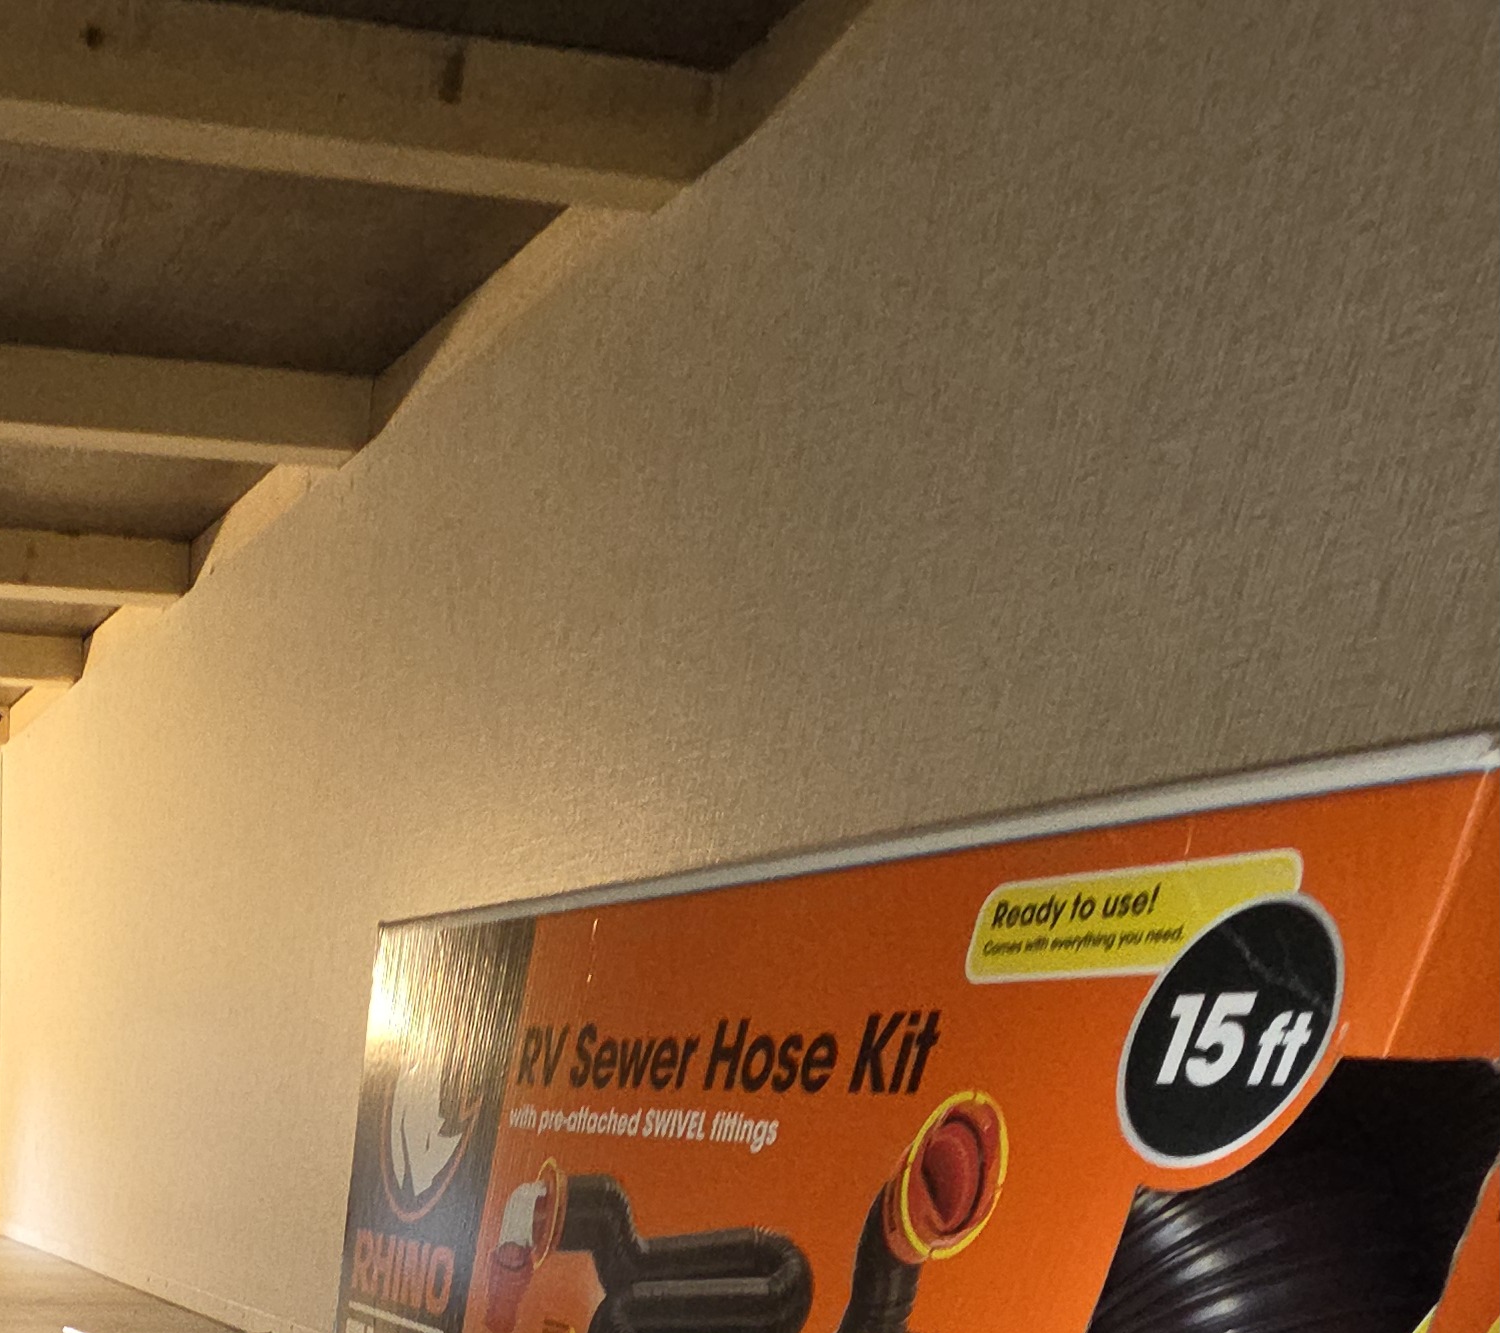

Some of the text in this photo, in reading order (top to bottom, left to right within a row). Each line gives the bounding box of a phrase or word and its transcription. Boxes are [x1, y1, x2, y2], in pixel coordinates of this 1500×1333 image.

[991, 881, 1162, 930] Ready to use!
[1050, 931, 1116, 952] everything
[1118, 931, 1143, 950] you
[517, 1009, 945, 1095] RV Sewer Hose Kit
[1155, 989, 1314, 1087] 15 ft
[509, 1104, 779, 1154] with pre-attached SWIVEL fittings
[351, 1228, 455, 1316] RHINO
